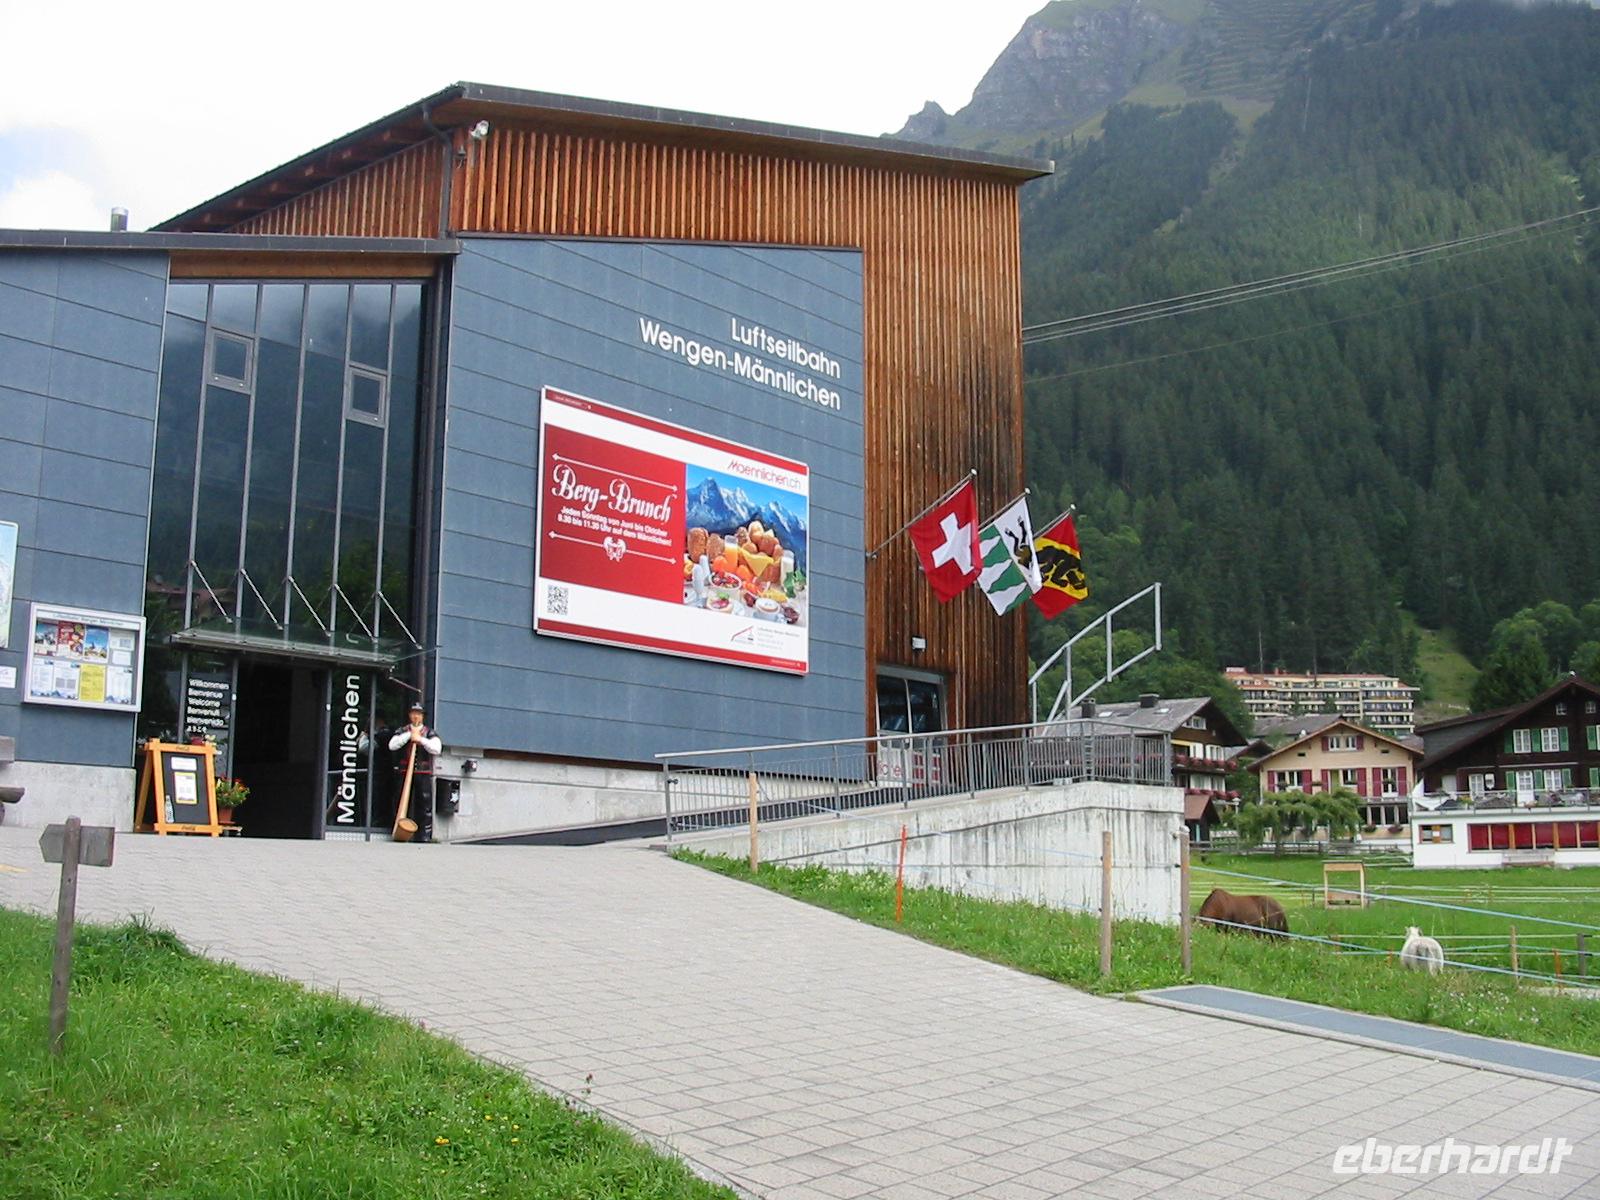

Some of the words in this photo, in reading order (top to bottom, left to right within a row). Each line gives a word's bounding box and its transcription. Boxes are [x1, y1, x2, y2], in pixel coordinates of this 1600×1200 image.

[639, 317, 841, 411] Wengen-Männlichen
[731, 317, 841, 379] Luftseilbahn
[551, 464, 678, 525] Berg-Brunch
[572, 517, 583, 527] bis
[188, 697, 221, 708] Welcome
[337, 674, 361, 824] Männlichen
